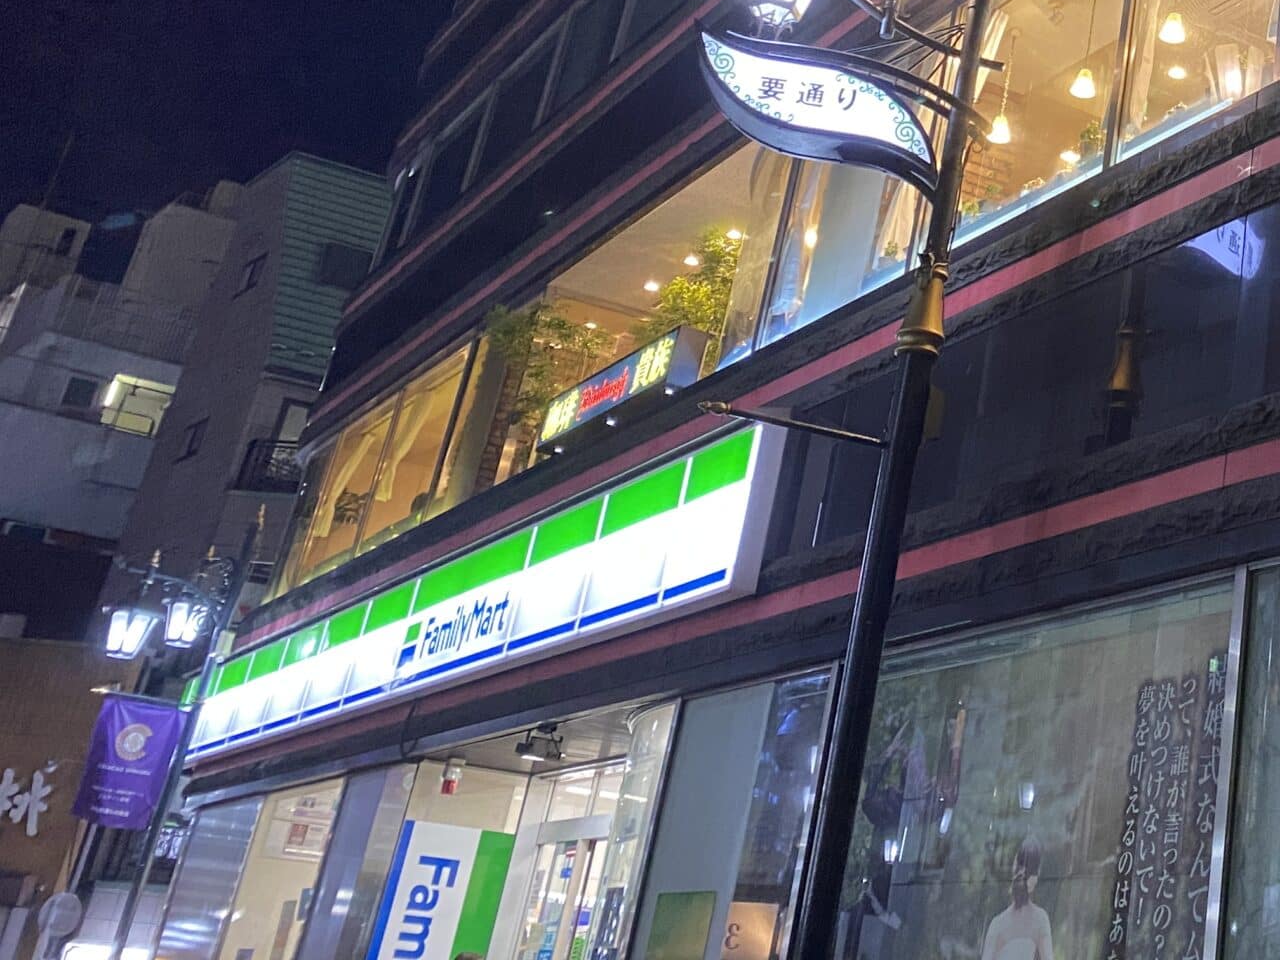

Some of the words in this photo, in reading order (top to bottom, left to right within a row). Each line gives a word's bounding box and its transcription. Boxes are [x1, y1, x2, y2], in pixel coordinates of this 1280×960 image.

[757, 76, 857, 111] 要通り
[419, 592, 509, 659] FamilyMart
[393, 855, 460, 960] Fam
